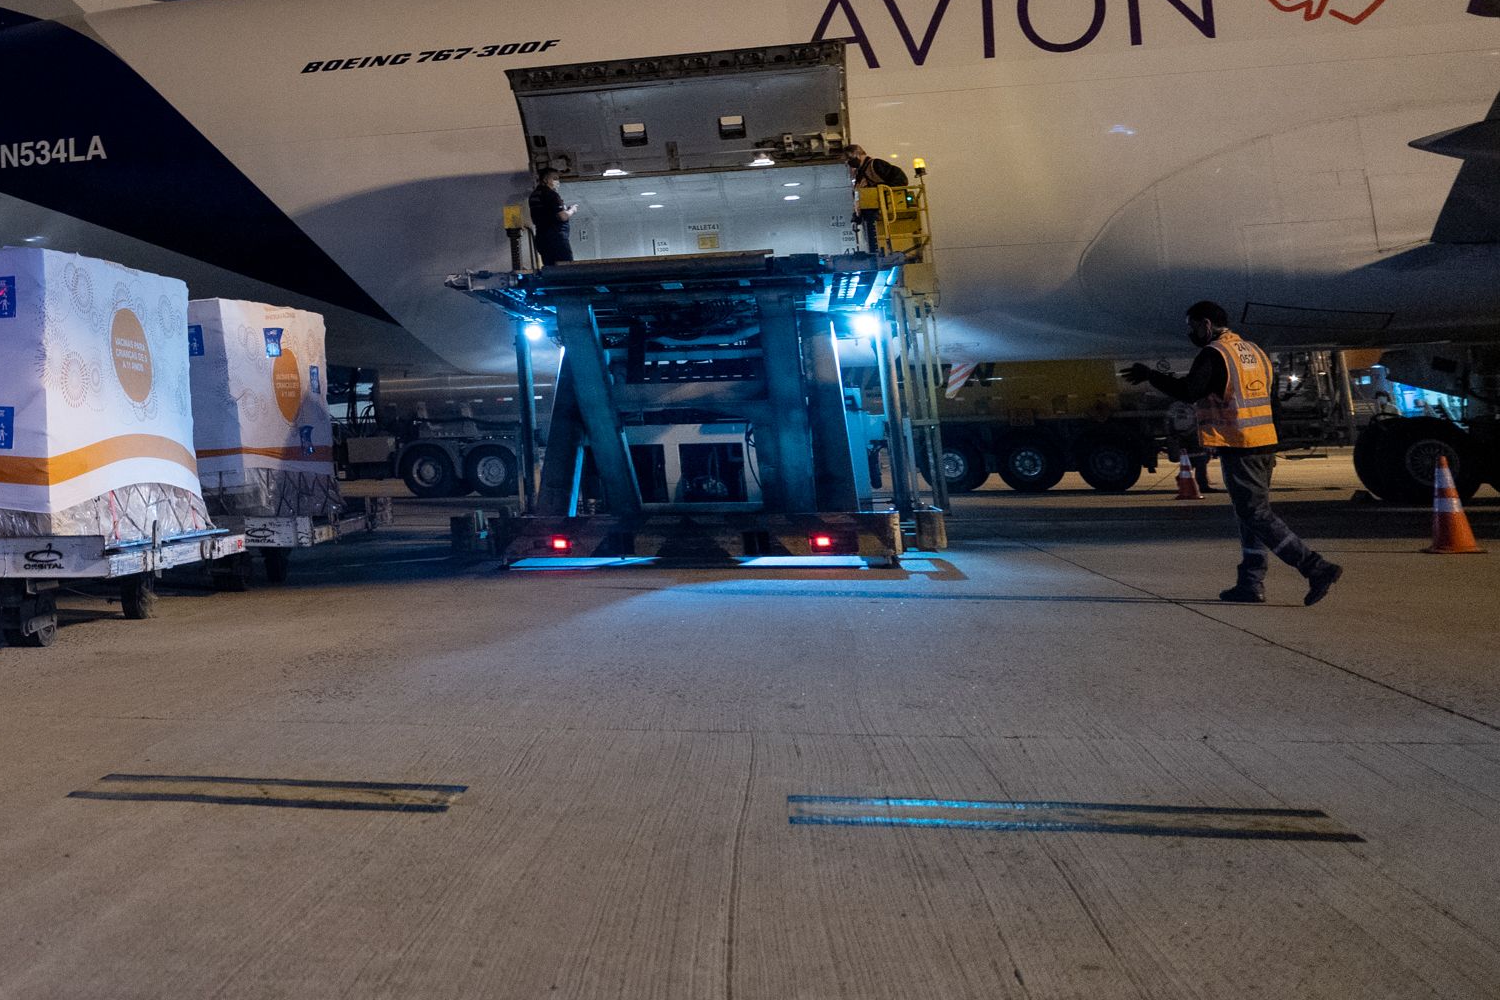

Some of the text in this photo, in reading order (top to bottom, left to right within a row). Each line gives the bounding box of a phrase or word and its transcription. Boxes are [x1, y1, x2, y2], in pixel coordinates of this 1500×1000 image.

[301, 39, 561, 74] BOEING 767-300F
[0, 135, 107, 168] N534LA
